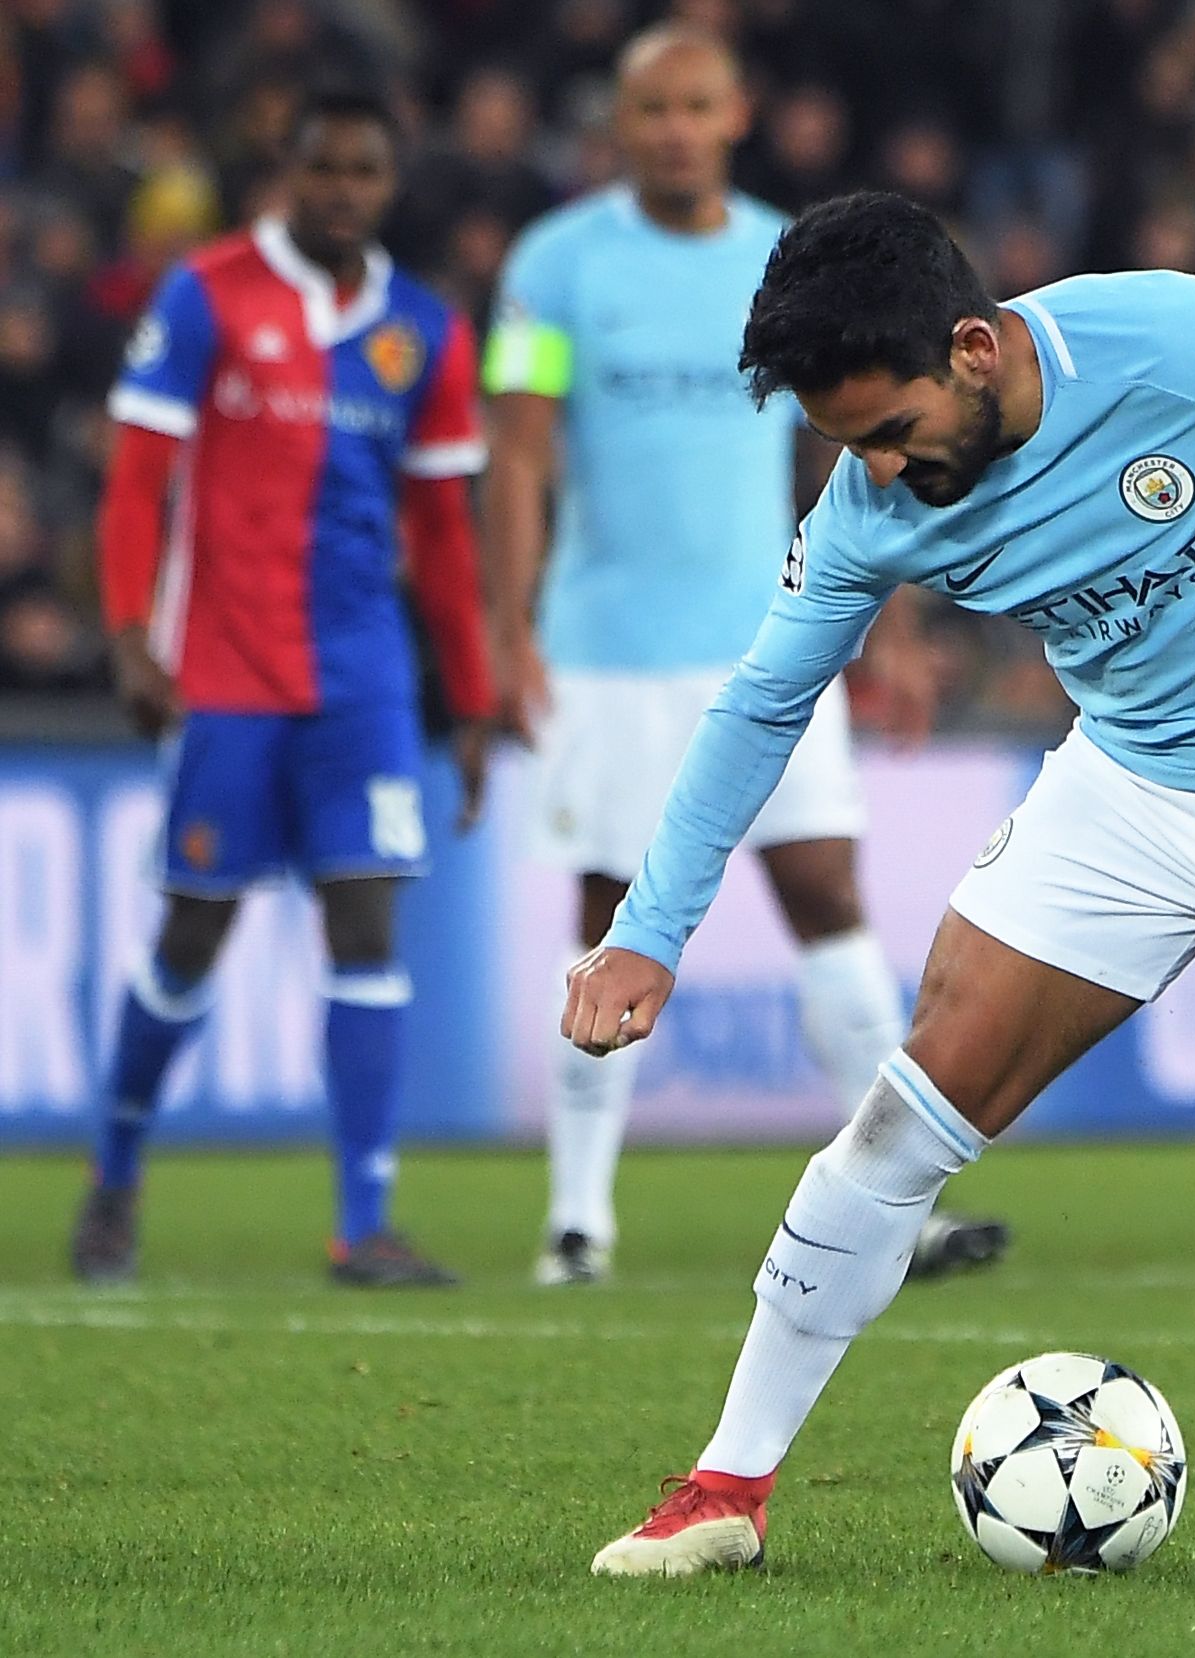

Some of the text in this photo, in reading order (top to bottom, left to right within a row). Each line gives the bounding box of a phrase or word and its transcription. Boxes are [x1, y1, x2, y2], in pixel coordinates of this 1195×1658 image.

[1125, 459, 1176, 493] MANCHESTER
[1164, 503, 1185, 518] CITY
[765, 1256, 818, 1296] CITY
